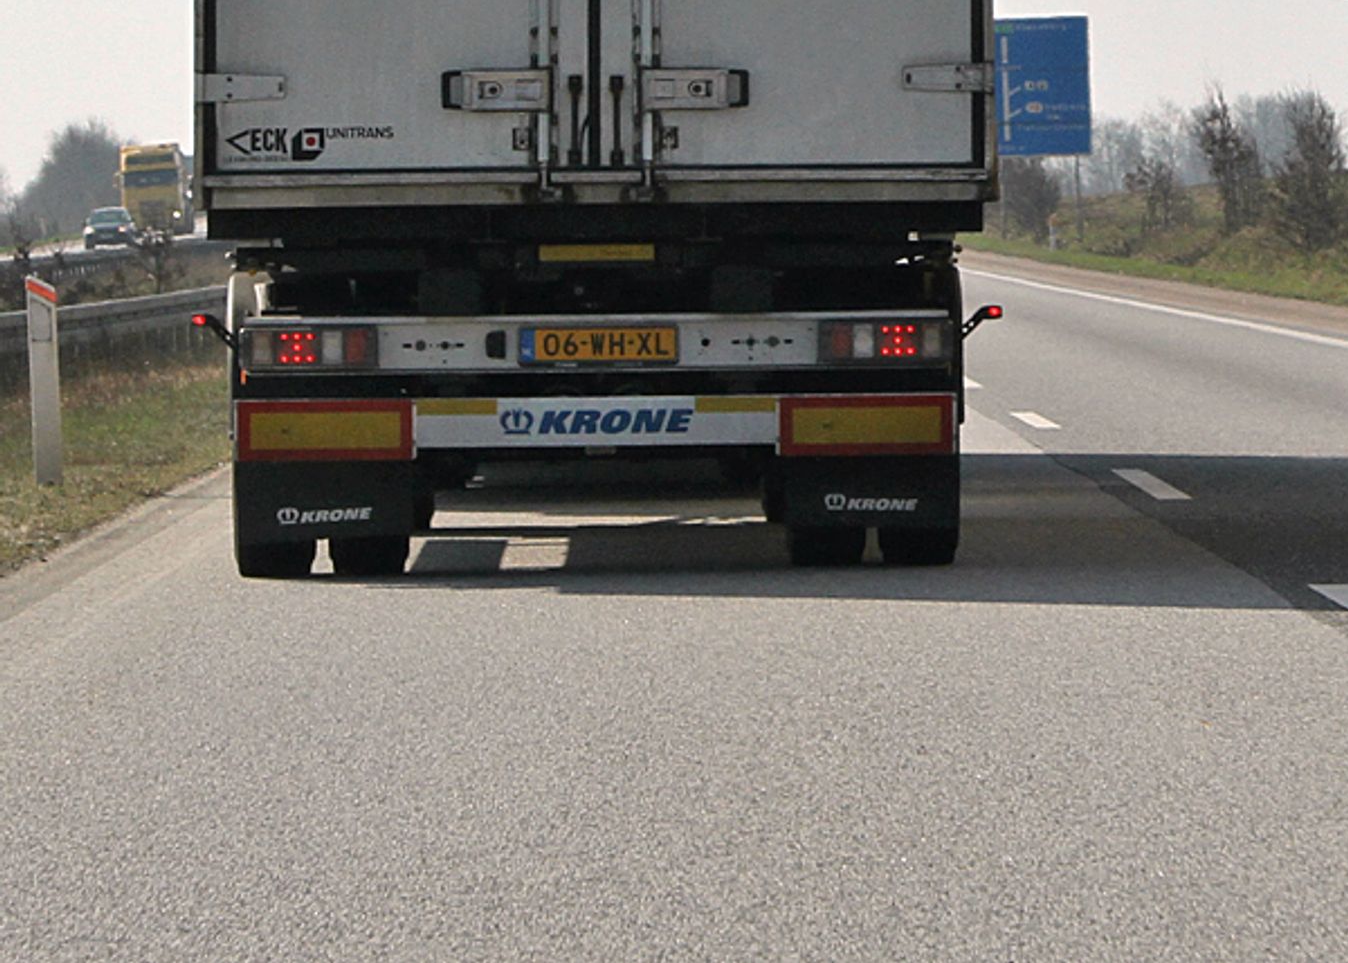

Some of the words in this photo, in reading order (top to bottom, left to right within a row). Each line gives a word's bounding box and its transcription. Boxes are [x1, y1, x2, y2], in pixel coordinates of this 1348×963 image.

[325, 126, 394, 140] UNITRANS
[542, 332, 669, 357] 06-WH-XL
[538, 408, 694, 435] KRONE
[846, 497, 919, 511] KRONE
[300, 506, 373, 525] KRONE
